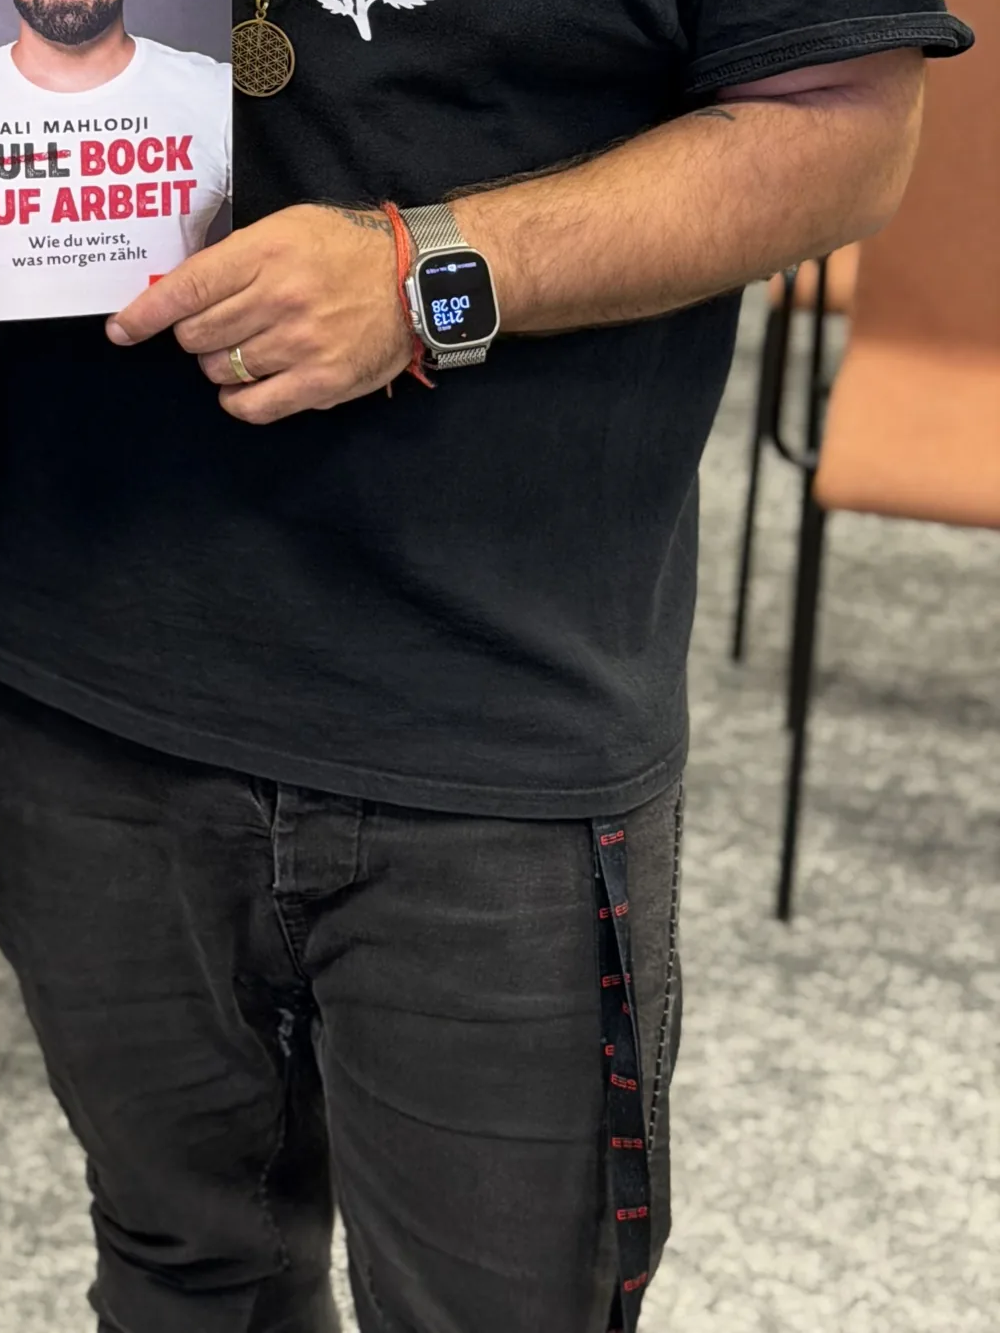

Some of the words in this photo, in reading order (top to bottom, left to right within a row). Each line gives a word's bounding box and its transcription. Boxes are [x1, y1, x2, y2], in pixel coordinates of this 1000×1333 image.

[0, 121, 31, 135] ALI
[43, 117, 149, 134] MAHLODJI
[80, 135, 194, 177] BOCK
[51, 179, 197, 223] ARBEIT
[28, 236, 60, 249] Wie
[63, 234, 83, 247] du
[86, 232, 131, 246] wirst,
[12, 255, 43, 267] was
[47, 252, 106, 267] morgen
[110, 247, 148, 261] zählt
[431, 299, 449, 313] 28
[450, 295, 470, 309] DO
